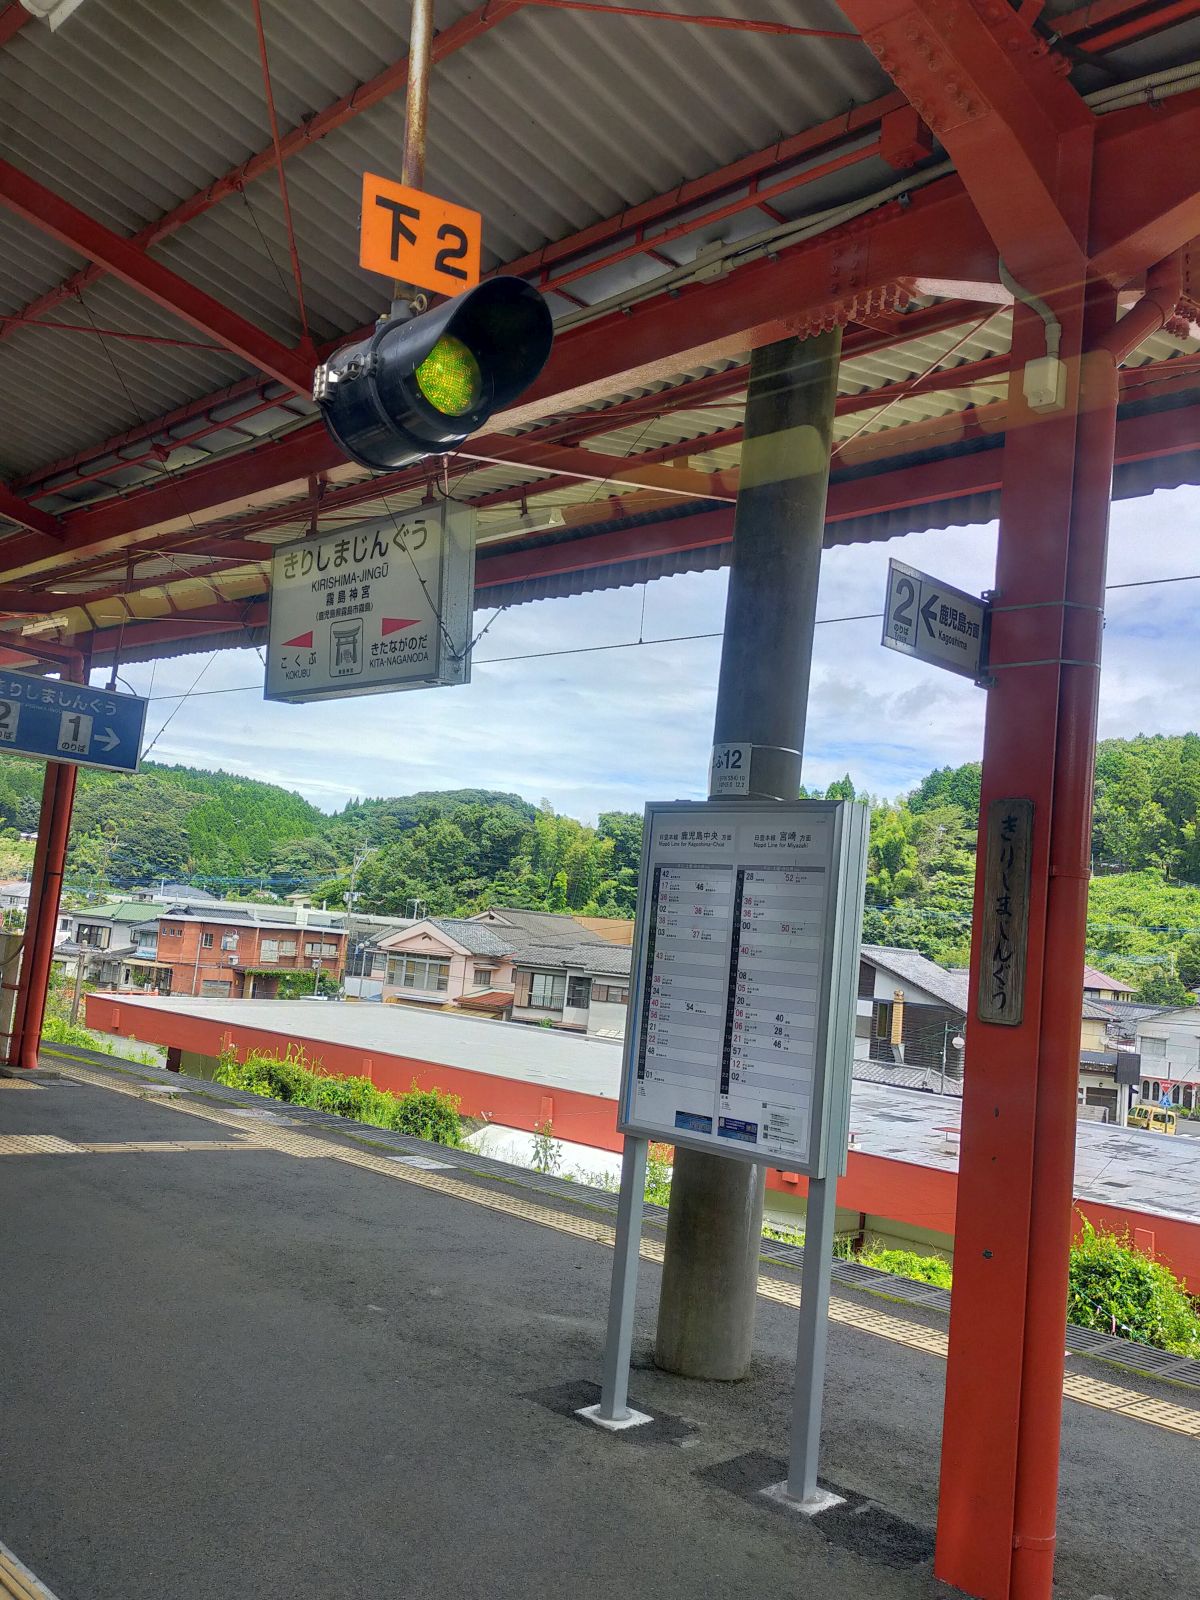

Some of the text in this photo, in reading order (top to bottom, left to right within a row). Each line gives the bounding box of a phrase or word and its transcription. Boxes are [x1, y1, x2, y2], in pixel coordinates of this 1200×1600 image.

[284, 519, 428, 580] きりしまじんぐう
[311, 563, 389, 592] KIRISHIMA-JINGŪ
[325, 585, 371, 606] 霧島神宮
[893, 578, 915, 627] 2
[939, 604, 980, 640] 鹿児島方面
[370, 635, 428, 656] きたながのだ
[938, 630, 968, 650] Kagoshima
[281, 651, 317, 669] こくぶ
[369, 652, 429, 668] KITA-NAGANODA
[285, 668, 312, 680] KOKUBU
[68, 716, 81, 742] 1
[61, 742, 87, 753] のりば
[681, 831, 718, 842] 鹿児島中央
[780, 831, 797, 842] 宮崎
[662, 870, 670, 878] 42
[746, 872, 754, 881] 28
[744, 897, 752, 905] 36
[659, 905, 667, 913] 02
[657, 928, 665, 936] 03
[742, 922, 751, 930] 00
[781, 925, 790, 933] 50
[656, 952, 663, 960] 43
[741, 947, 749, 955] 40
[739, 972, 747, 980] 08
[737, 997, 745, 1005] 20
[686, 1003, 694, 1011] 54
[735, 1009, 744, 1017] 06
[775, 1014, 784, 1023] 40
[649, 1022, 656, 1030] 21
[734, 1022, 743, 1030] 06
[774, 1027, 783, 1035] 28
[648, 1035, 656, 1043] 22
[733, 1035, 741, 1043] 21
[773, 1040, 782, 1049] 46
[647, 1047, 655, 1055] 48
[732, 1047, 741, 1055] 57
[732, 1060, 741, 1068] 12
[646, 1071, 653, 1079] 01
[731, 1073, 740, 1081] 02
